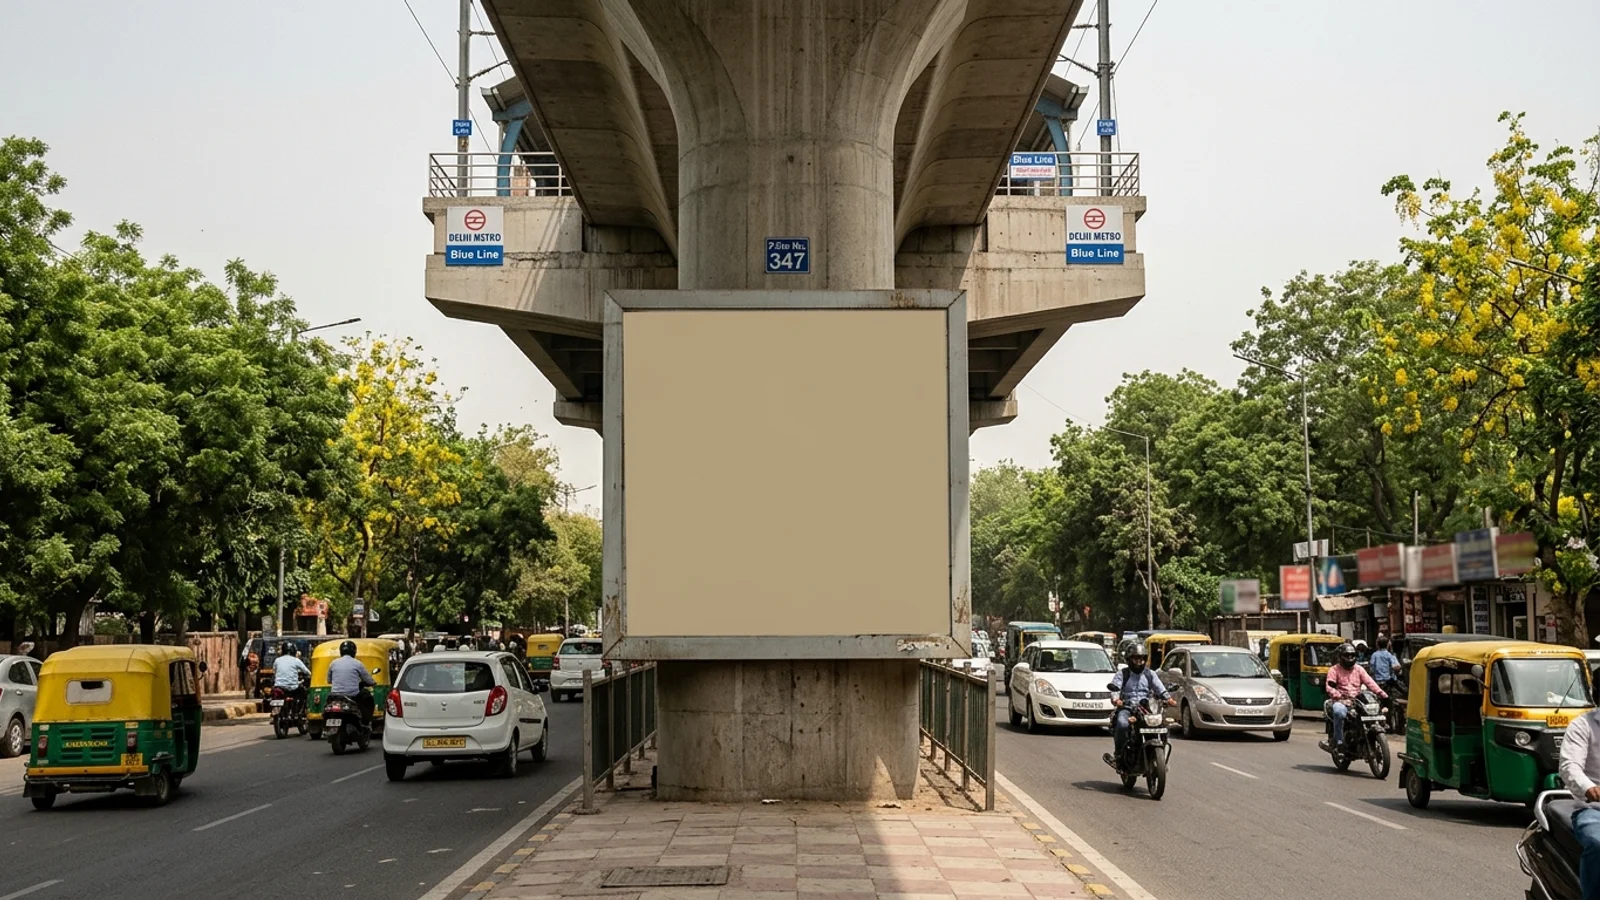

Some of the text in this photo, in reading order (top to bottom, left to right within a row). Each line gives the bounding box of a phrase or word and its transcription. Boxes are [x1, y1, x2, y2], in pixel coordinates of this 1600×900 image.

[477, 250, 499, 259] Line
[1071, 249, 1119, 258] Blue Line
[769, 252, 805, 269] 347
